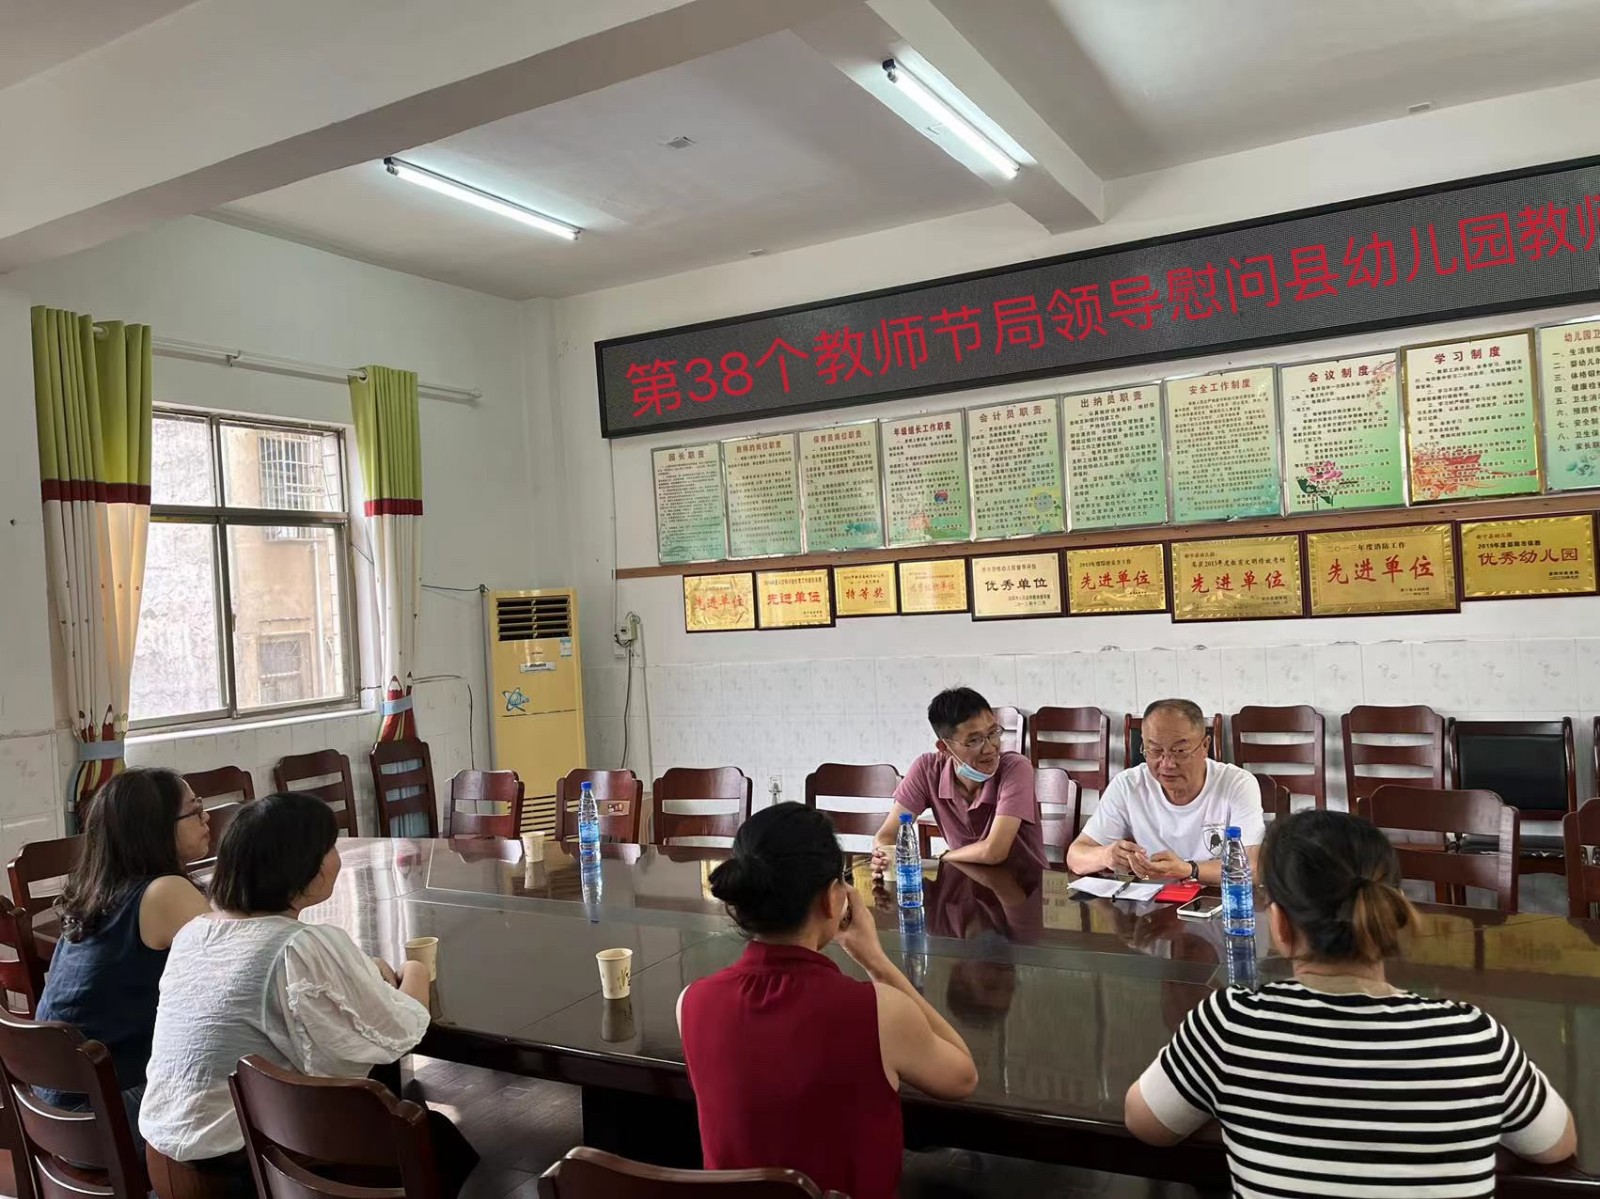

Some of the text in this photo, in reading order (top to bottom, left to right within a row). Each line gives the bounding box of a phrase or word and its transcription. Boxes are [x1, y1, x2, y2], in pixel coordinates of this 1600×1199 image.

[1434, 346, 1501, 364] 学习制度
[1308, 365, 1369, 382] 会议制度
[1189, 378, 1251, 395] 安全工作制度
[1080, 390, 1143, 408] 出纳员职责
[979, 405, 1043, 423] 会计员职责
[893, 421, 952, 437] 年级组长工作职责
[1478, 548, 1578, 566] 优秀幼儿园
[1328, 554, 1434, 584] 先进单位
[984, 577, 1048, 592] 优秀单位
[1081, 569, 1150, 591] 先进单位
[1191, 569, 1285, 593] 先进单位
[694, 593, 745, 611] 先进单位
[767, 591, 821, 606] 先进单位
[845, 586, 884, 600] 特等奖
